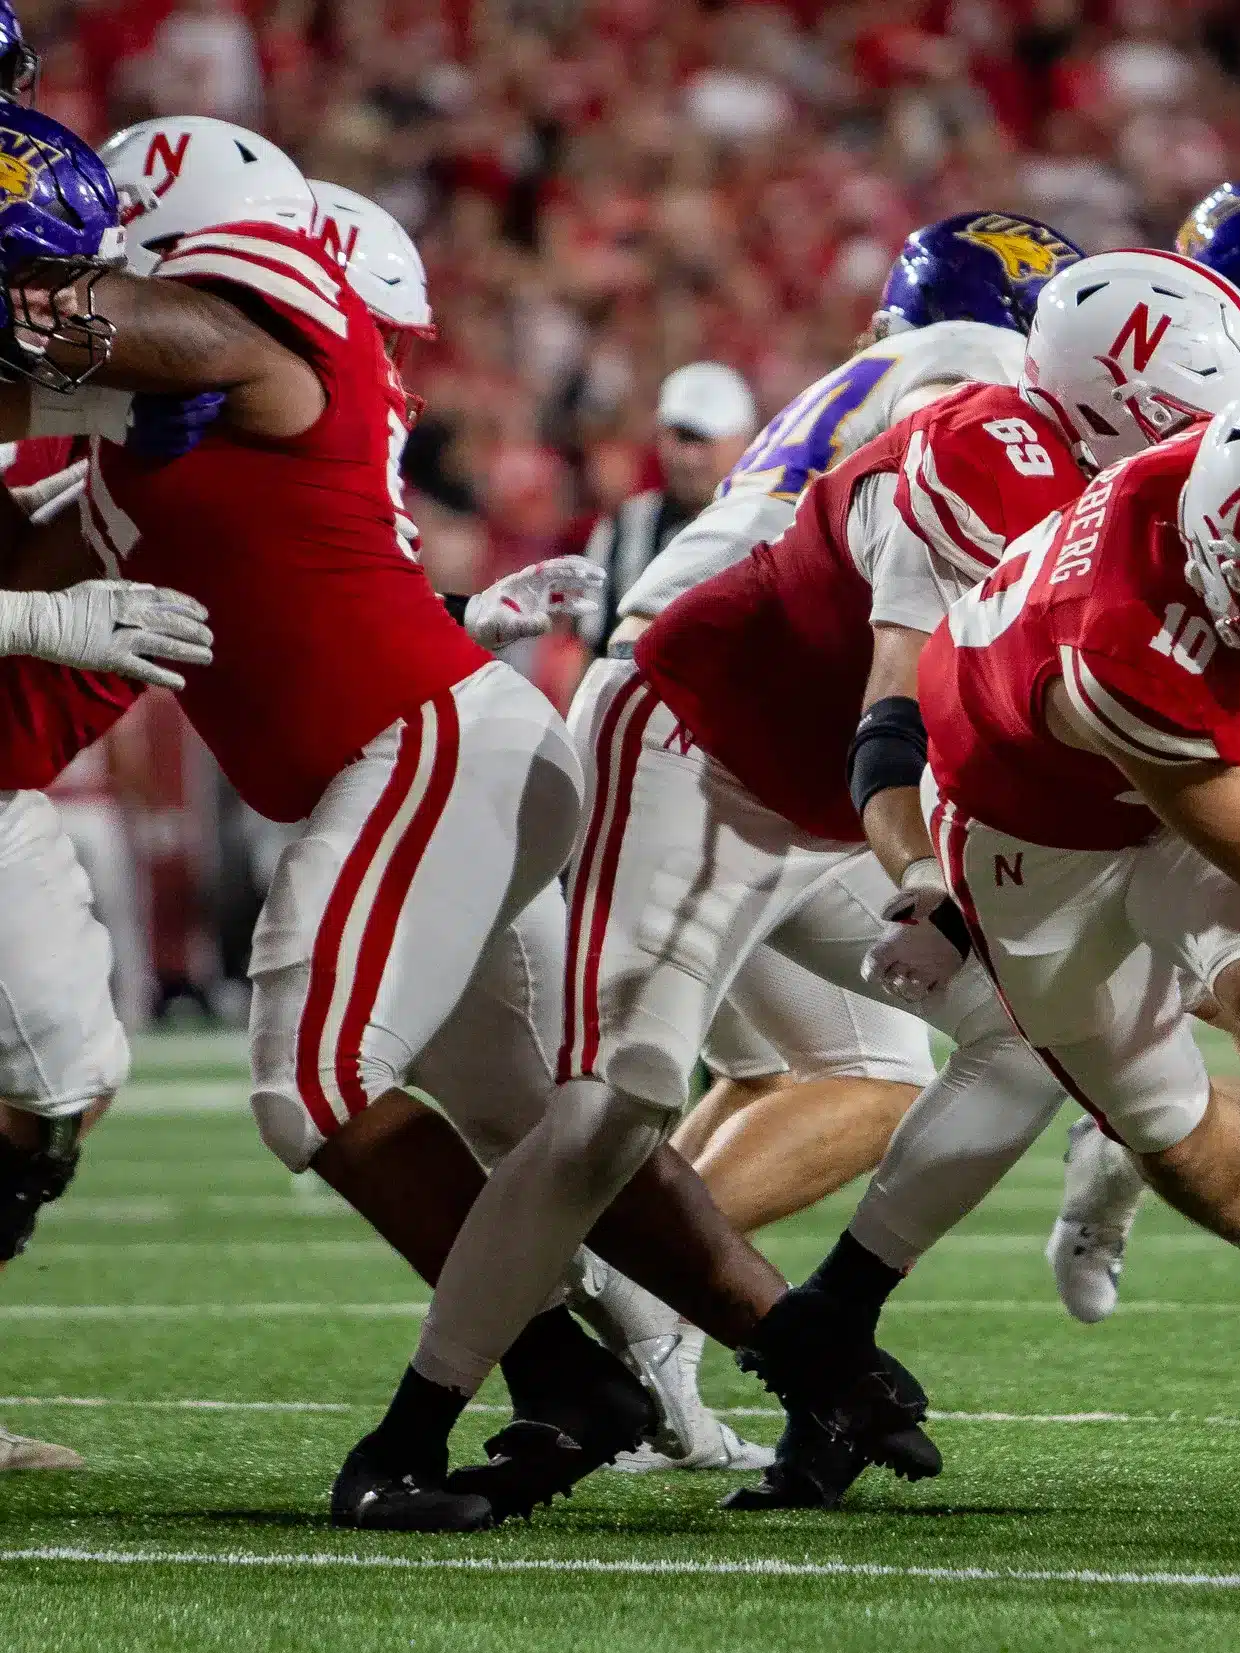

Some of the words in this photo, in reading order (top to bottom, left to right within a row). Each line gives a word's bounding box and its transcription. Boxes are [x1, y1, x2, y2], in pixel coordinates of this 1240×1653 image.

[143, 132, 192, 177] N
[317, 215, 360, 271] N
[1107, 301, 1172, 374] N
[982, 417, 1055, 477] 69
[1148, 602, 1218, 675] 10
[994, 852, 1024, 886] N
